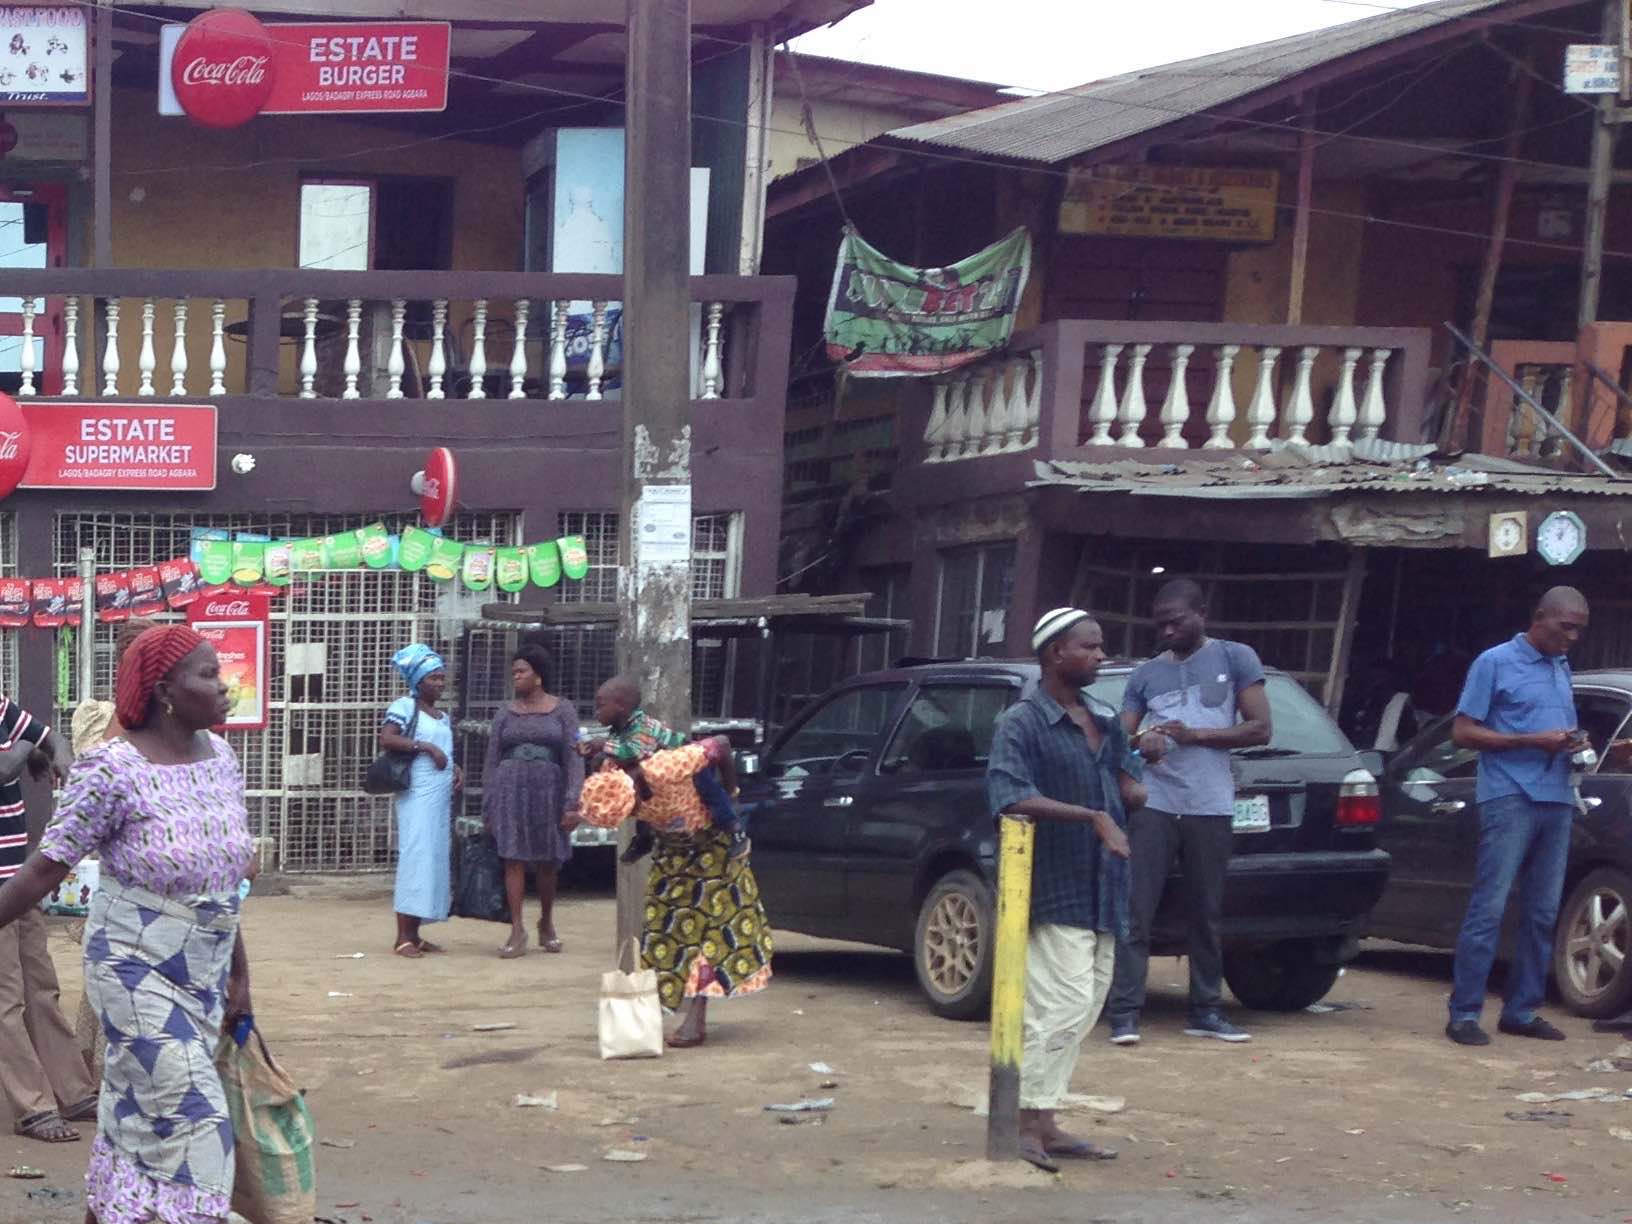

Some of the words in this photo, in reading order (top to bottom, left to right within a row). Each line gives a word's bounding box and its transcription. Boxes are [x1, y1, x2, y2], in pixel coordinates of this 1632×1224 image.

[310, 36, 418, 62] ESTATE
[183, 56, 269, 85] Coca-Cola
[319, 65, 405, 86] BURGER
[80, 419, 175, 441] ESTATE
[64, 445, 192, 465] SUPERMARKET
